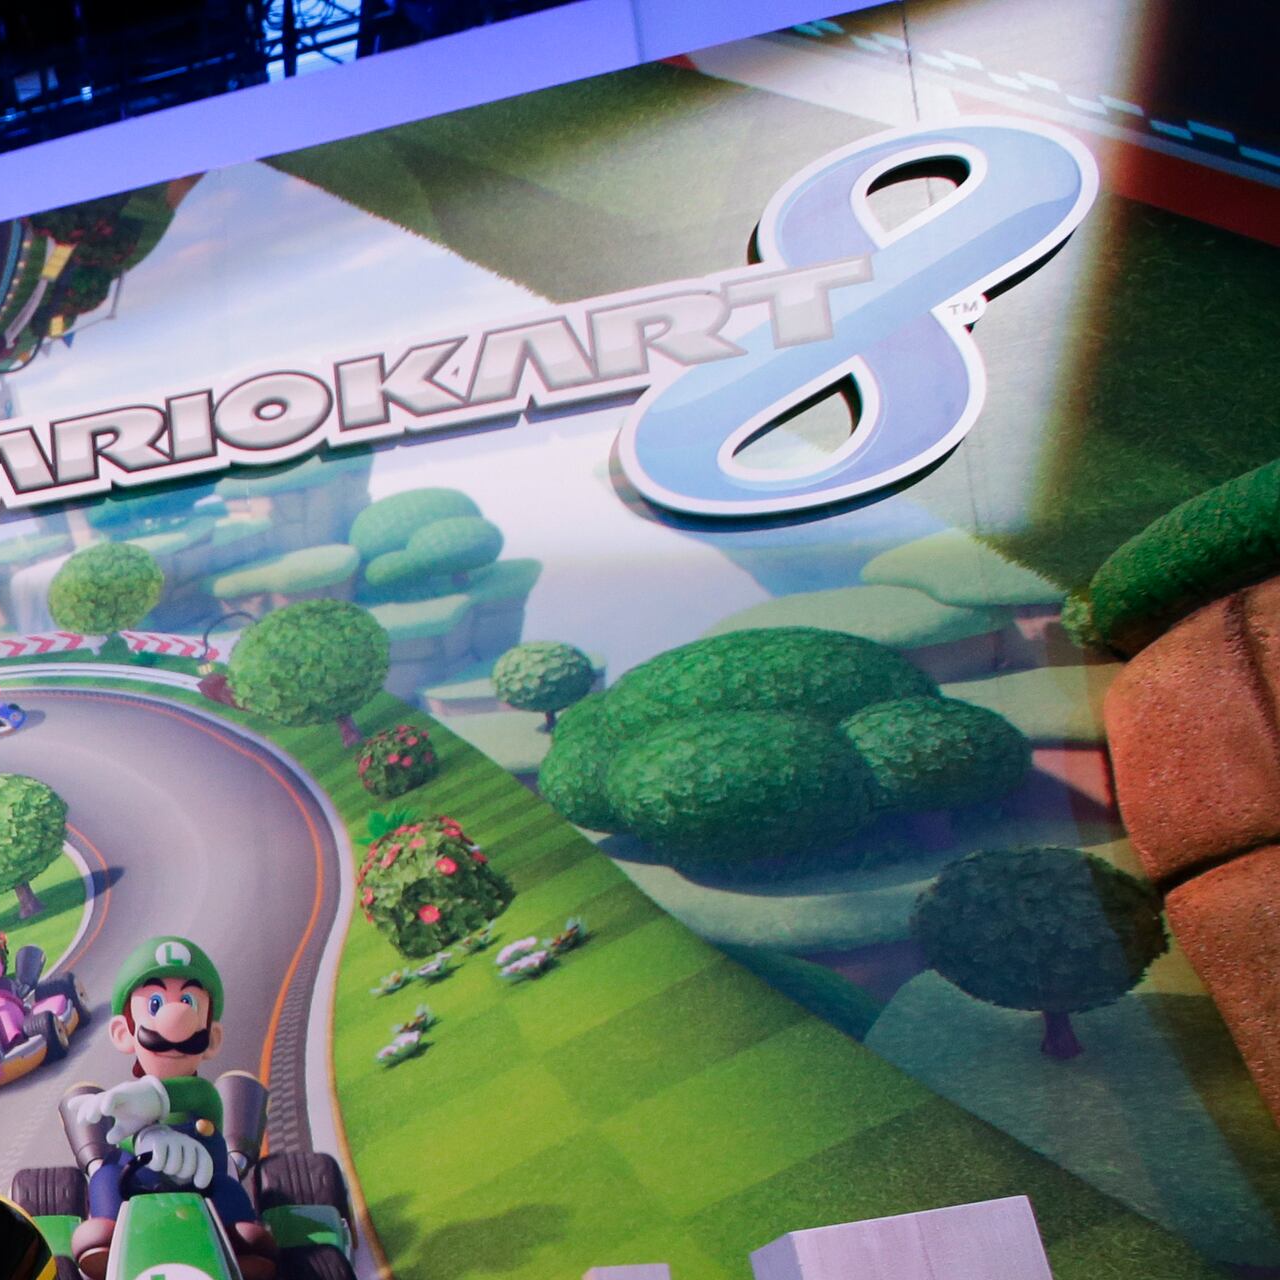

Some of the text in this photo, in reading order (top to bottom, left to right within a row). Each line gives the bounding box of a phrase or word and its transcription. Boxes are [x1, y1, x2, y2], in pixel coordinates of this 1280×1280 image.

[618, 115, 1100, 516] 8
[947, 300, 978, 315] TM
[165, 944, 183, 967] L
